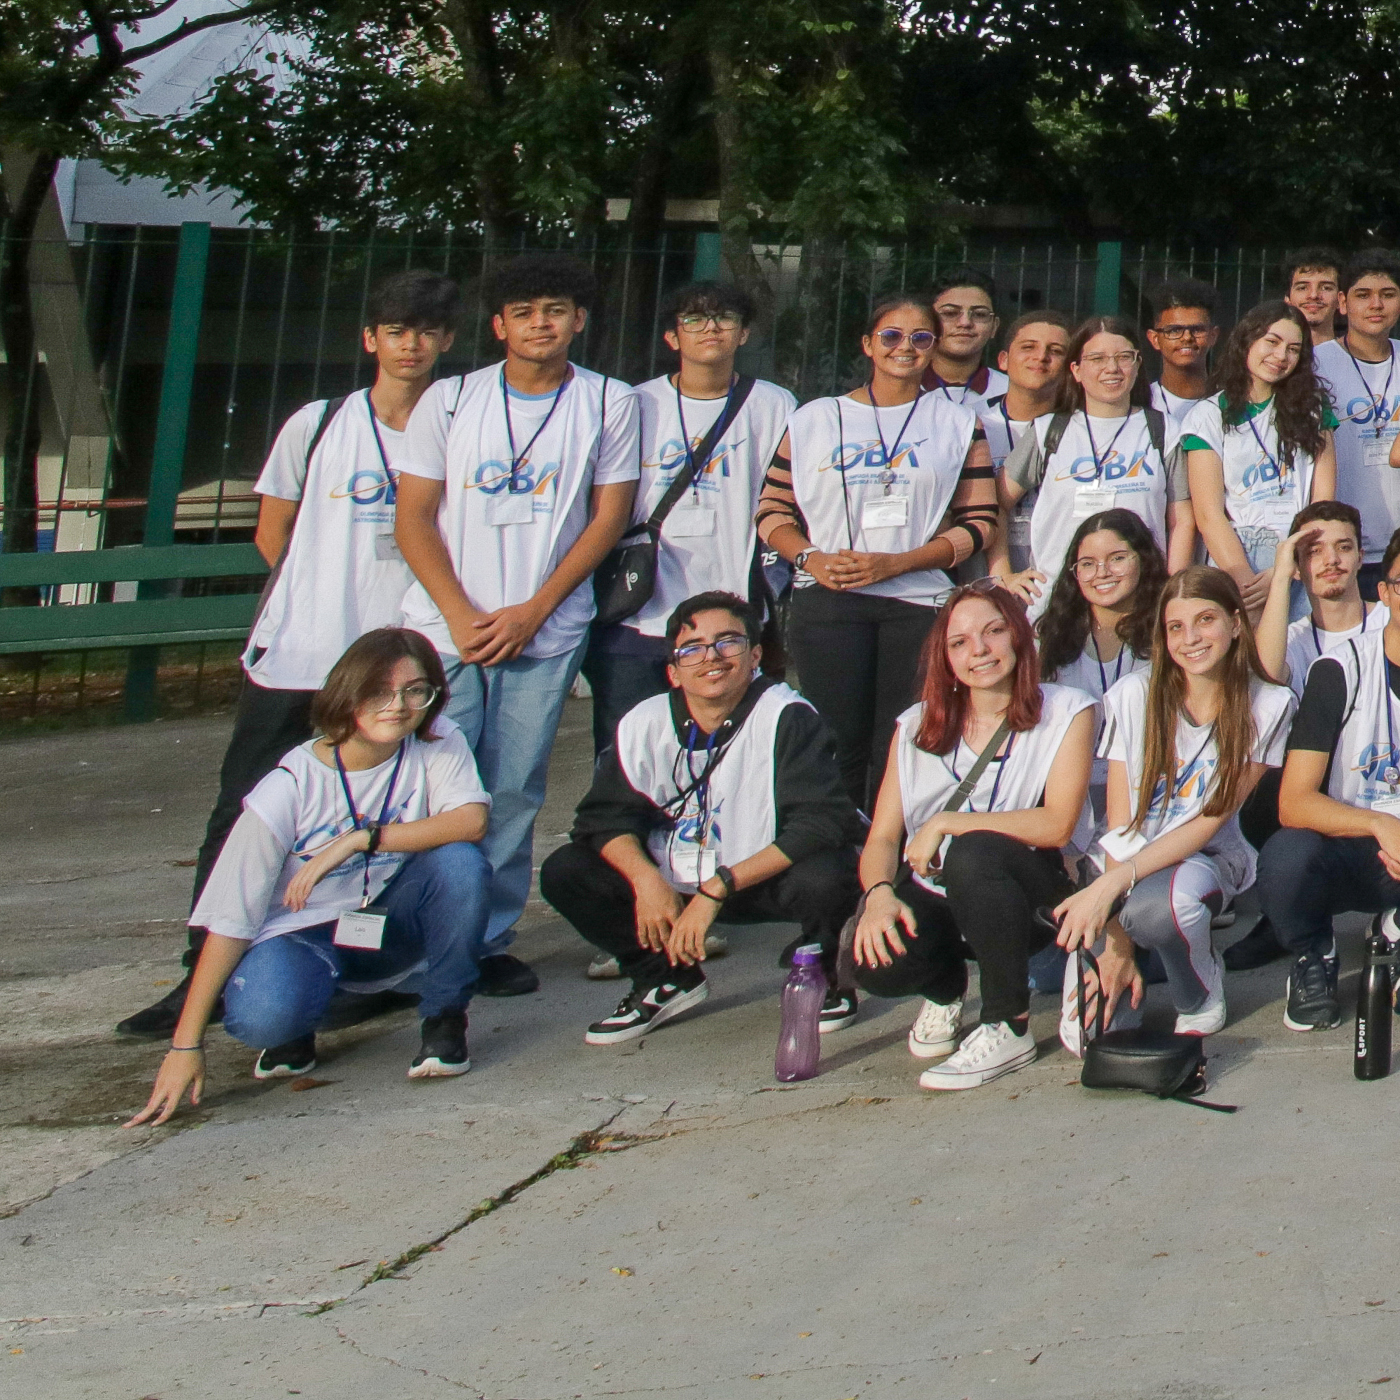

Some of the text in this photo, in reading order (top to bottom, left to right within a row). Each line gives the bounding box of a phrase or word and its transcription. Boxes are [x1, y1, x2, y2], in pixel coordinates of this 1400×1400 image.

[831, 440, 919, 468] OBA
[1070, 450, 1154, 483] OBA
[474, 458, 559, 496] OBA
[1358, 1017, 1366, 1048] SPORT
